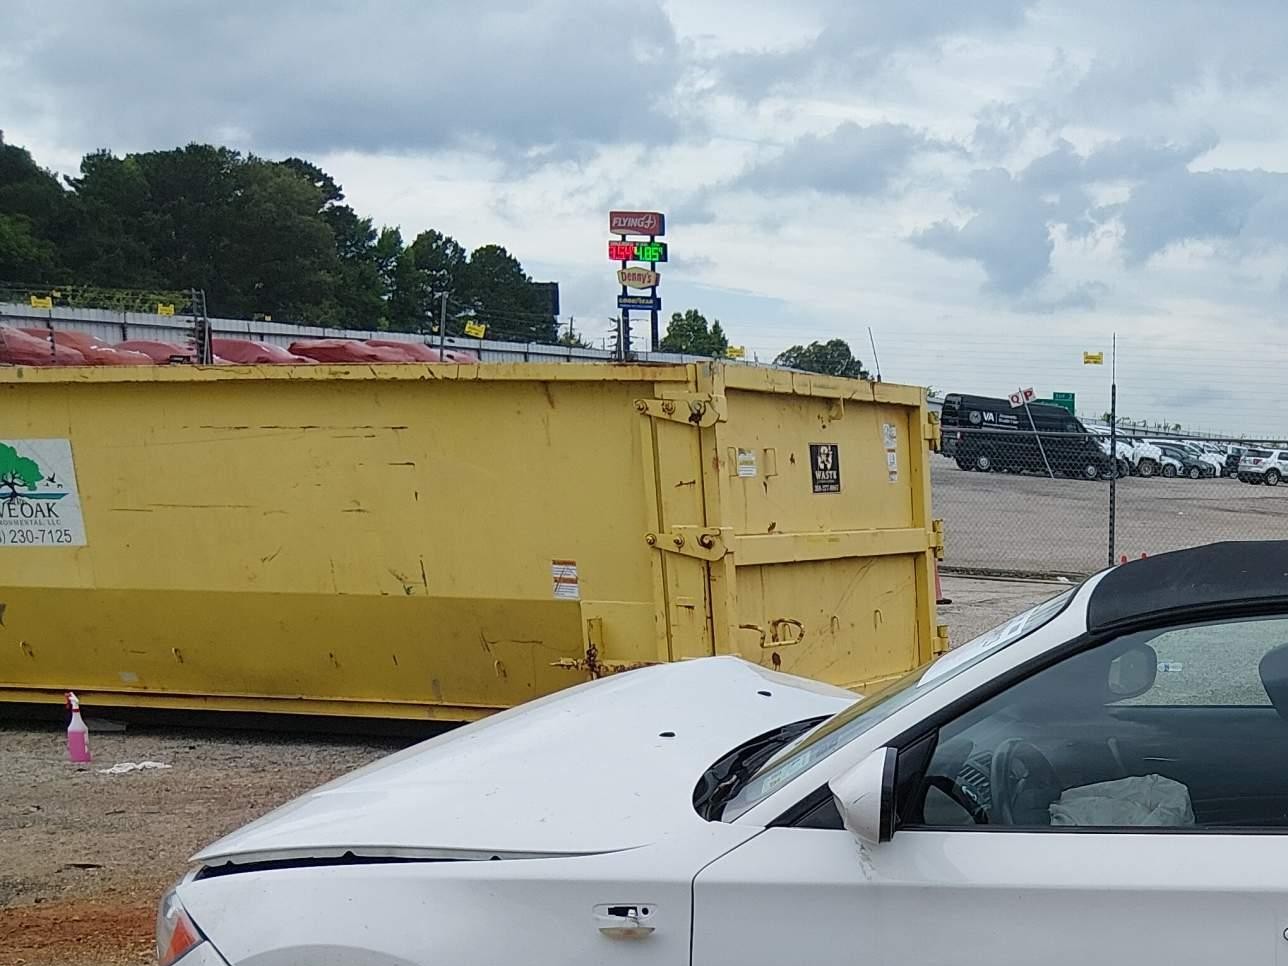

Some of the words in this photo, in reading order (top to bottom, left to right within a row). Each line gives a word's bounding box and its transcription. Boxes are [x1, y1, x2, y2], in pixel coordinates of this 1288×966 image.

[621, 271, 652, 284] Denny's
[1011, 395, 1020, 404] Q
[1024, 390, 1032, 401] P
[983, 411, 994, 421] VA
[815, 470, 837, 480] WASTE
[20, 502, 60, 518] OAK
[9, 529, 72, 544] 230-7125
